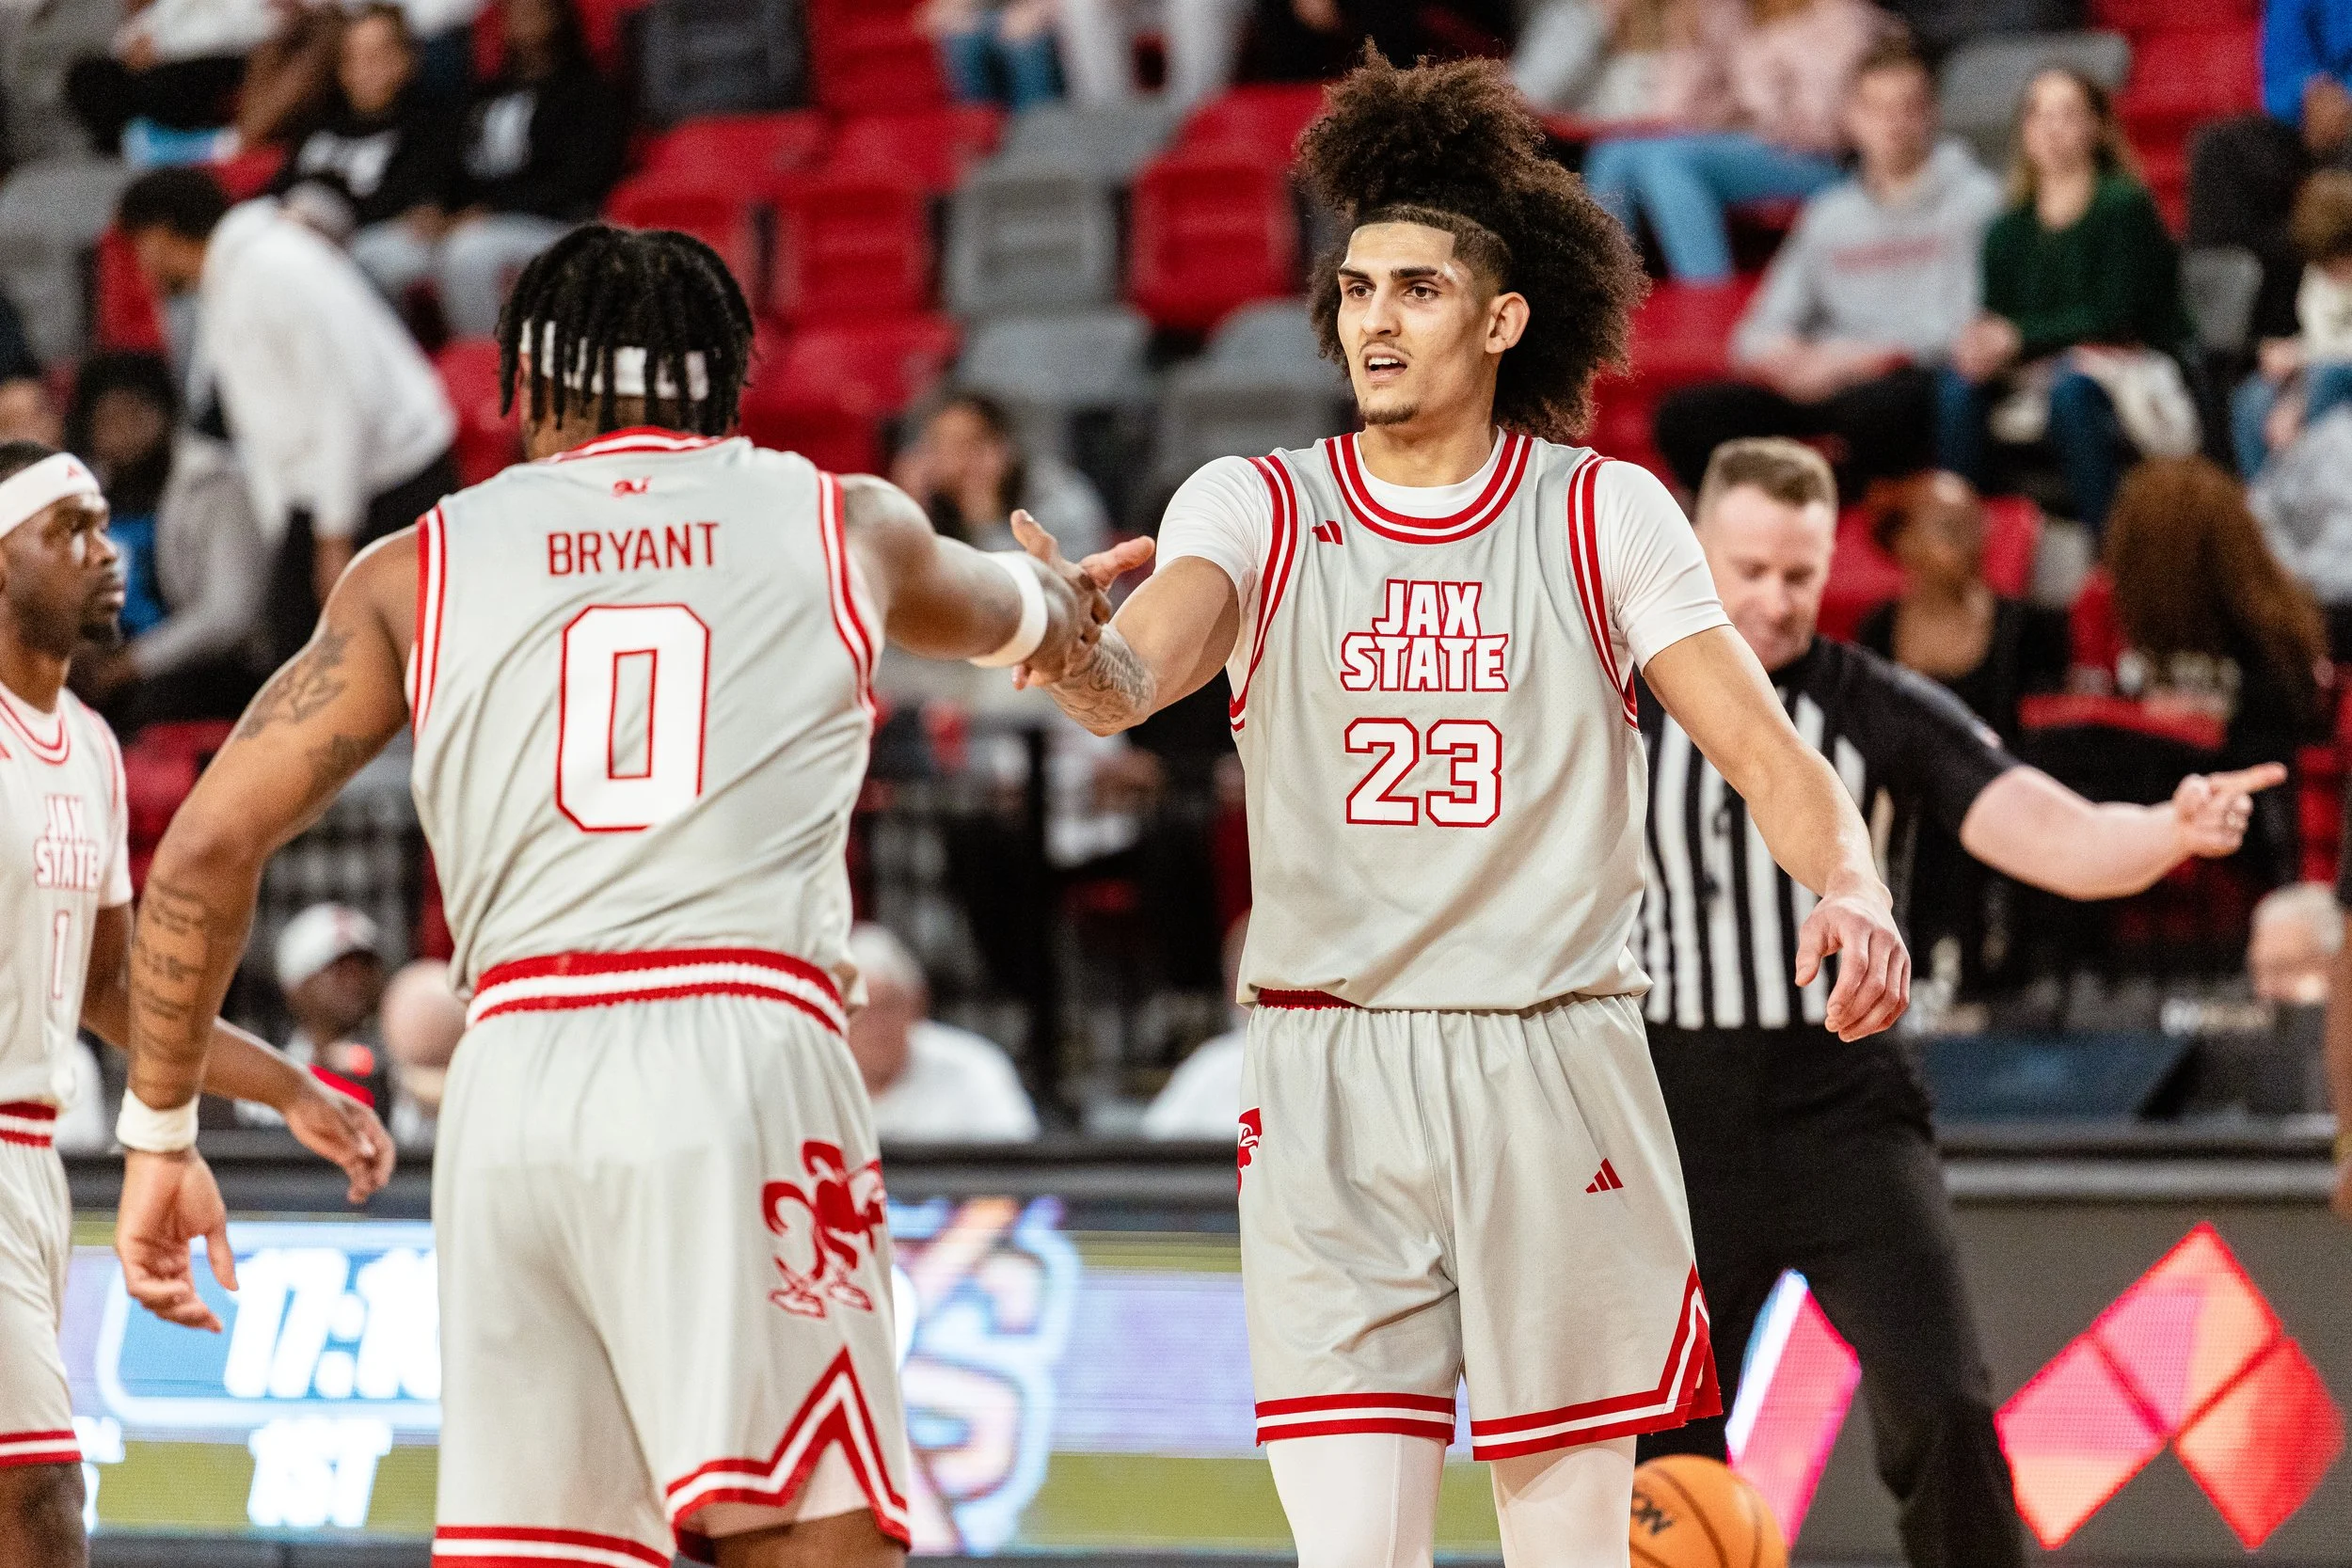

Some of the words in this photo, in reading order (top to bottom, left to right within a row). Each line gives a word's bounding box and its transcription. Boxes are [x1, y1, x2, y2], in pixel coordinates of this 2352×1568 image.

[548, 521, 721, 577] BRYANT
[1372, 578, 1483, 638] JAX
[1340, 632, 1509, 692] STATE
[555, 602, 712, 832] 0
[1343, 717, 1502, 828] 23
[44, 793, 85, 843] JAX
[34, 834, 99, 892] STATE
[51, 909, 71, 1000] 1
[247, 1417, 393, 1528] 1ST
